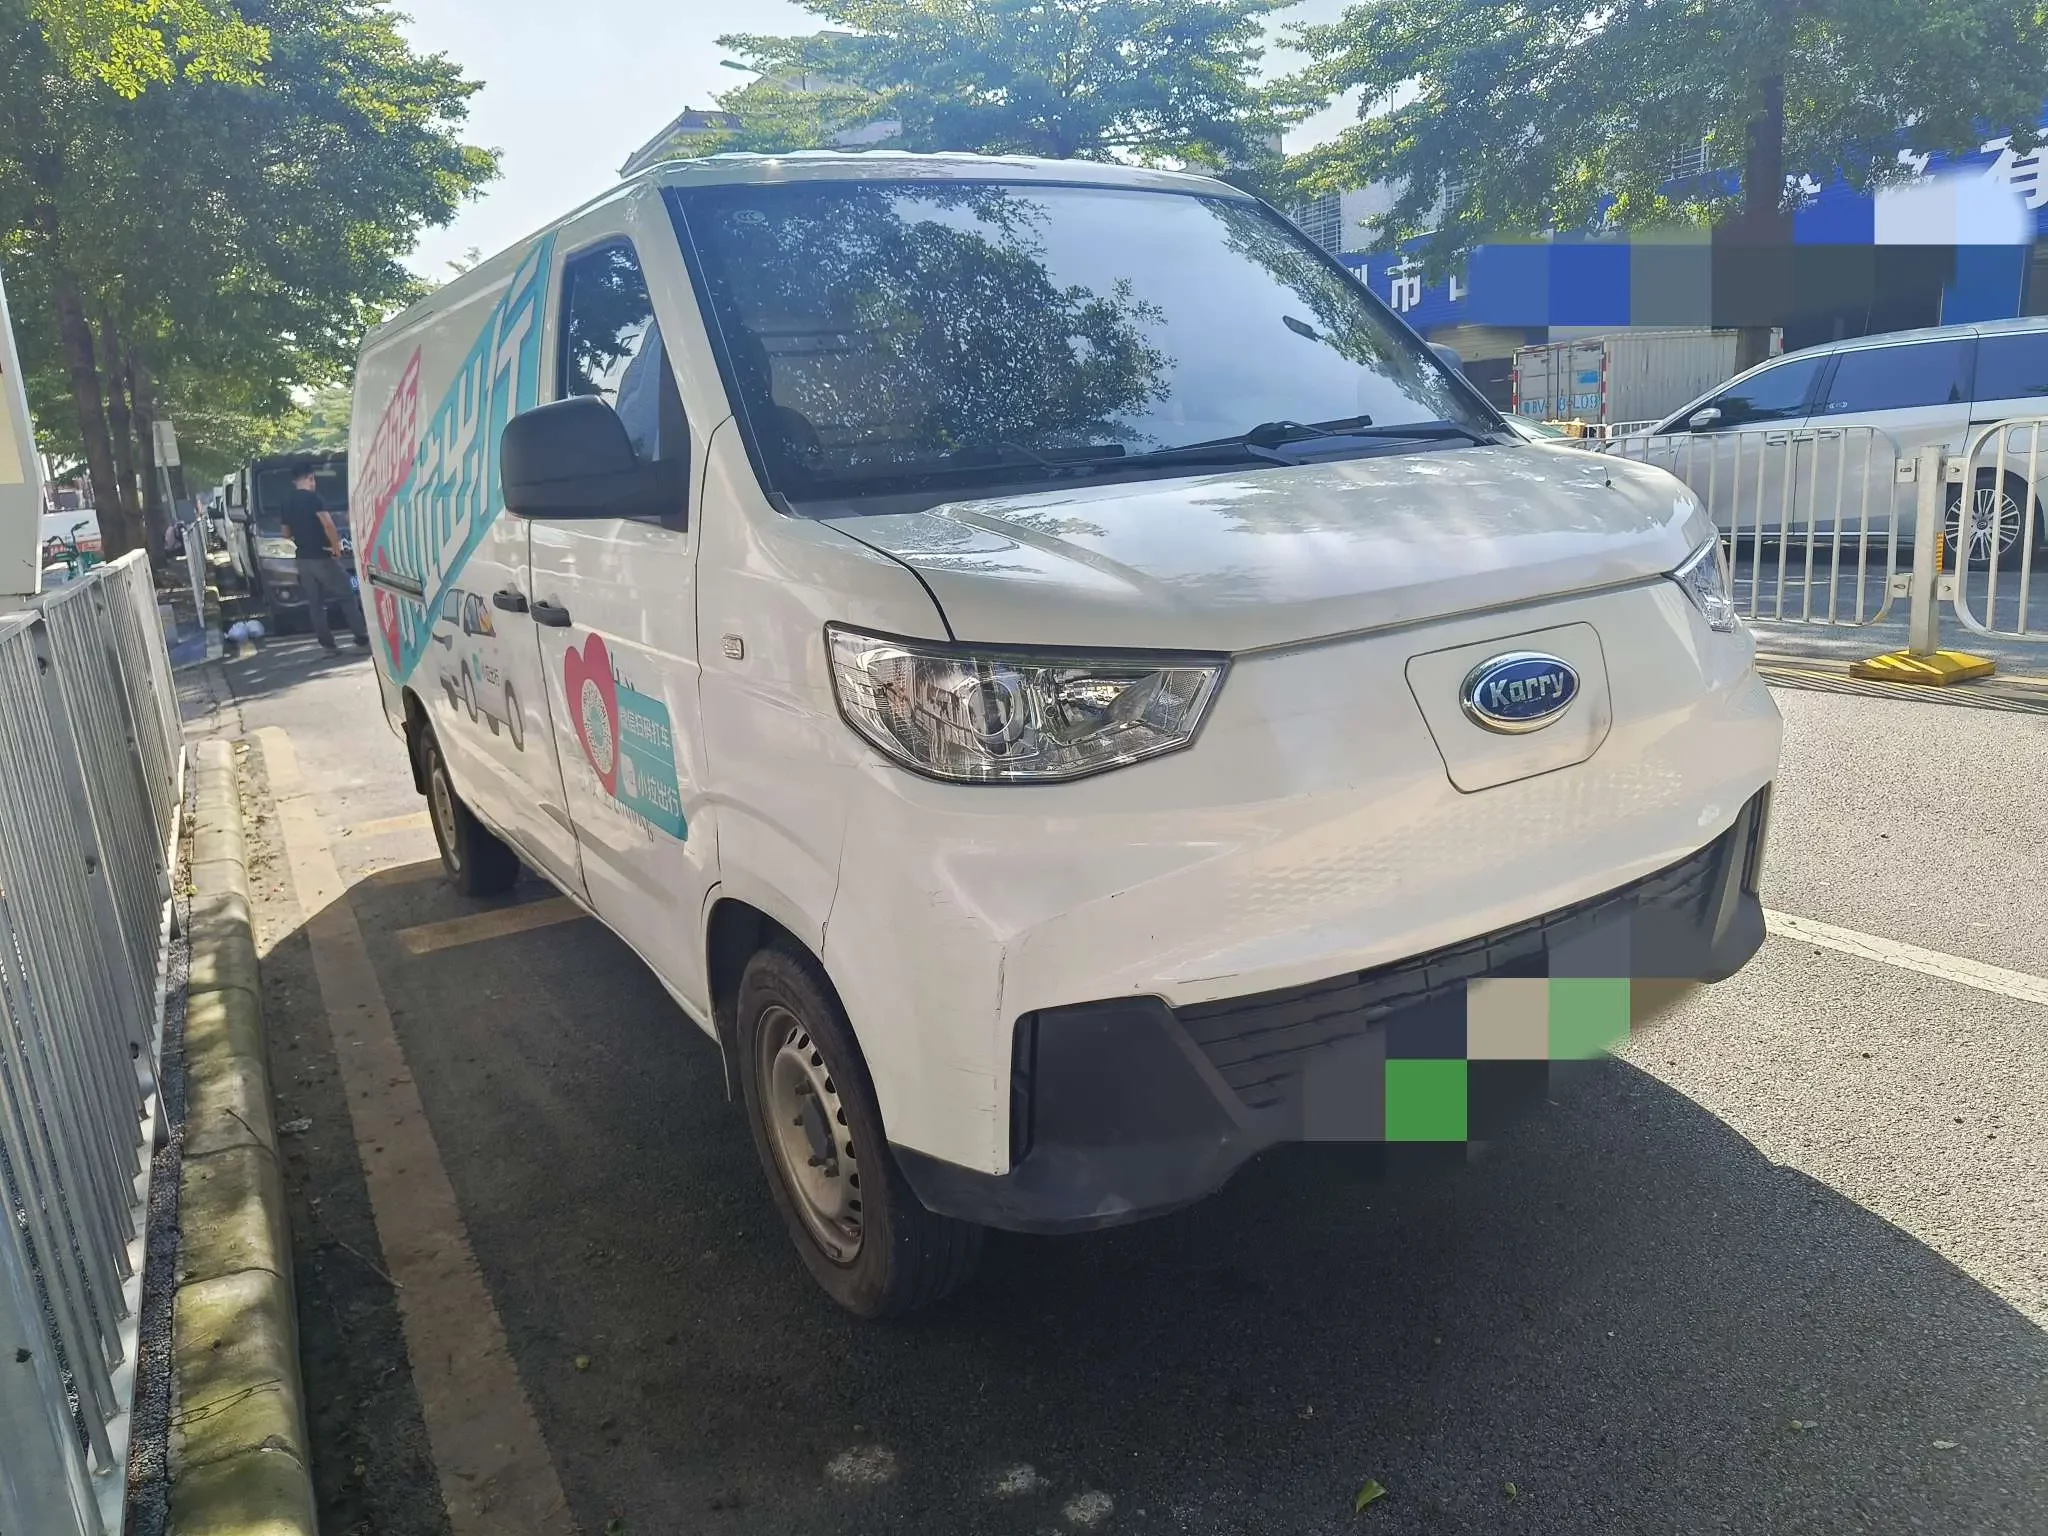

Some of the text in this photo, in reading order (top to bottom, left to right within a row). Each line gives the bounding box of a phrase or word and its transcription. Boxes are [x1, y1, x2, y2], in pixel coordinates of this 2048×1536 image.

[388, 244, 542, 648] 小拉出行
[1490, 672, 1564, 708] Karry
[638, 769, 680, 817] 小拉出行
